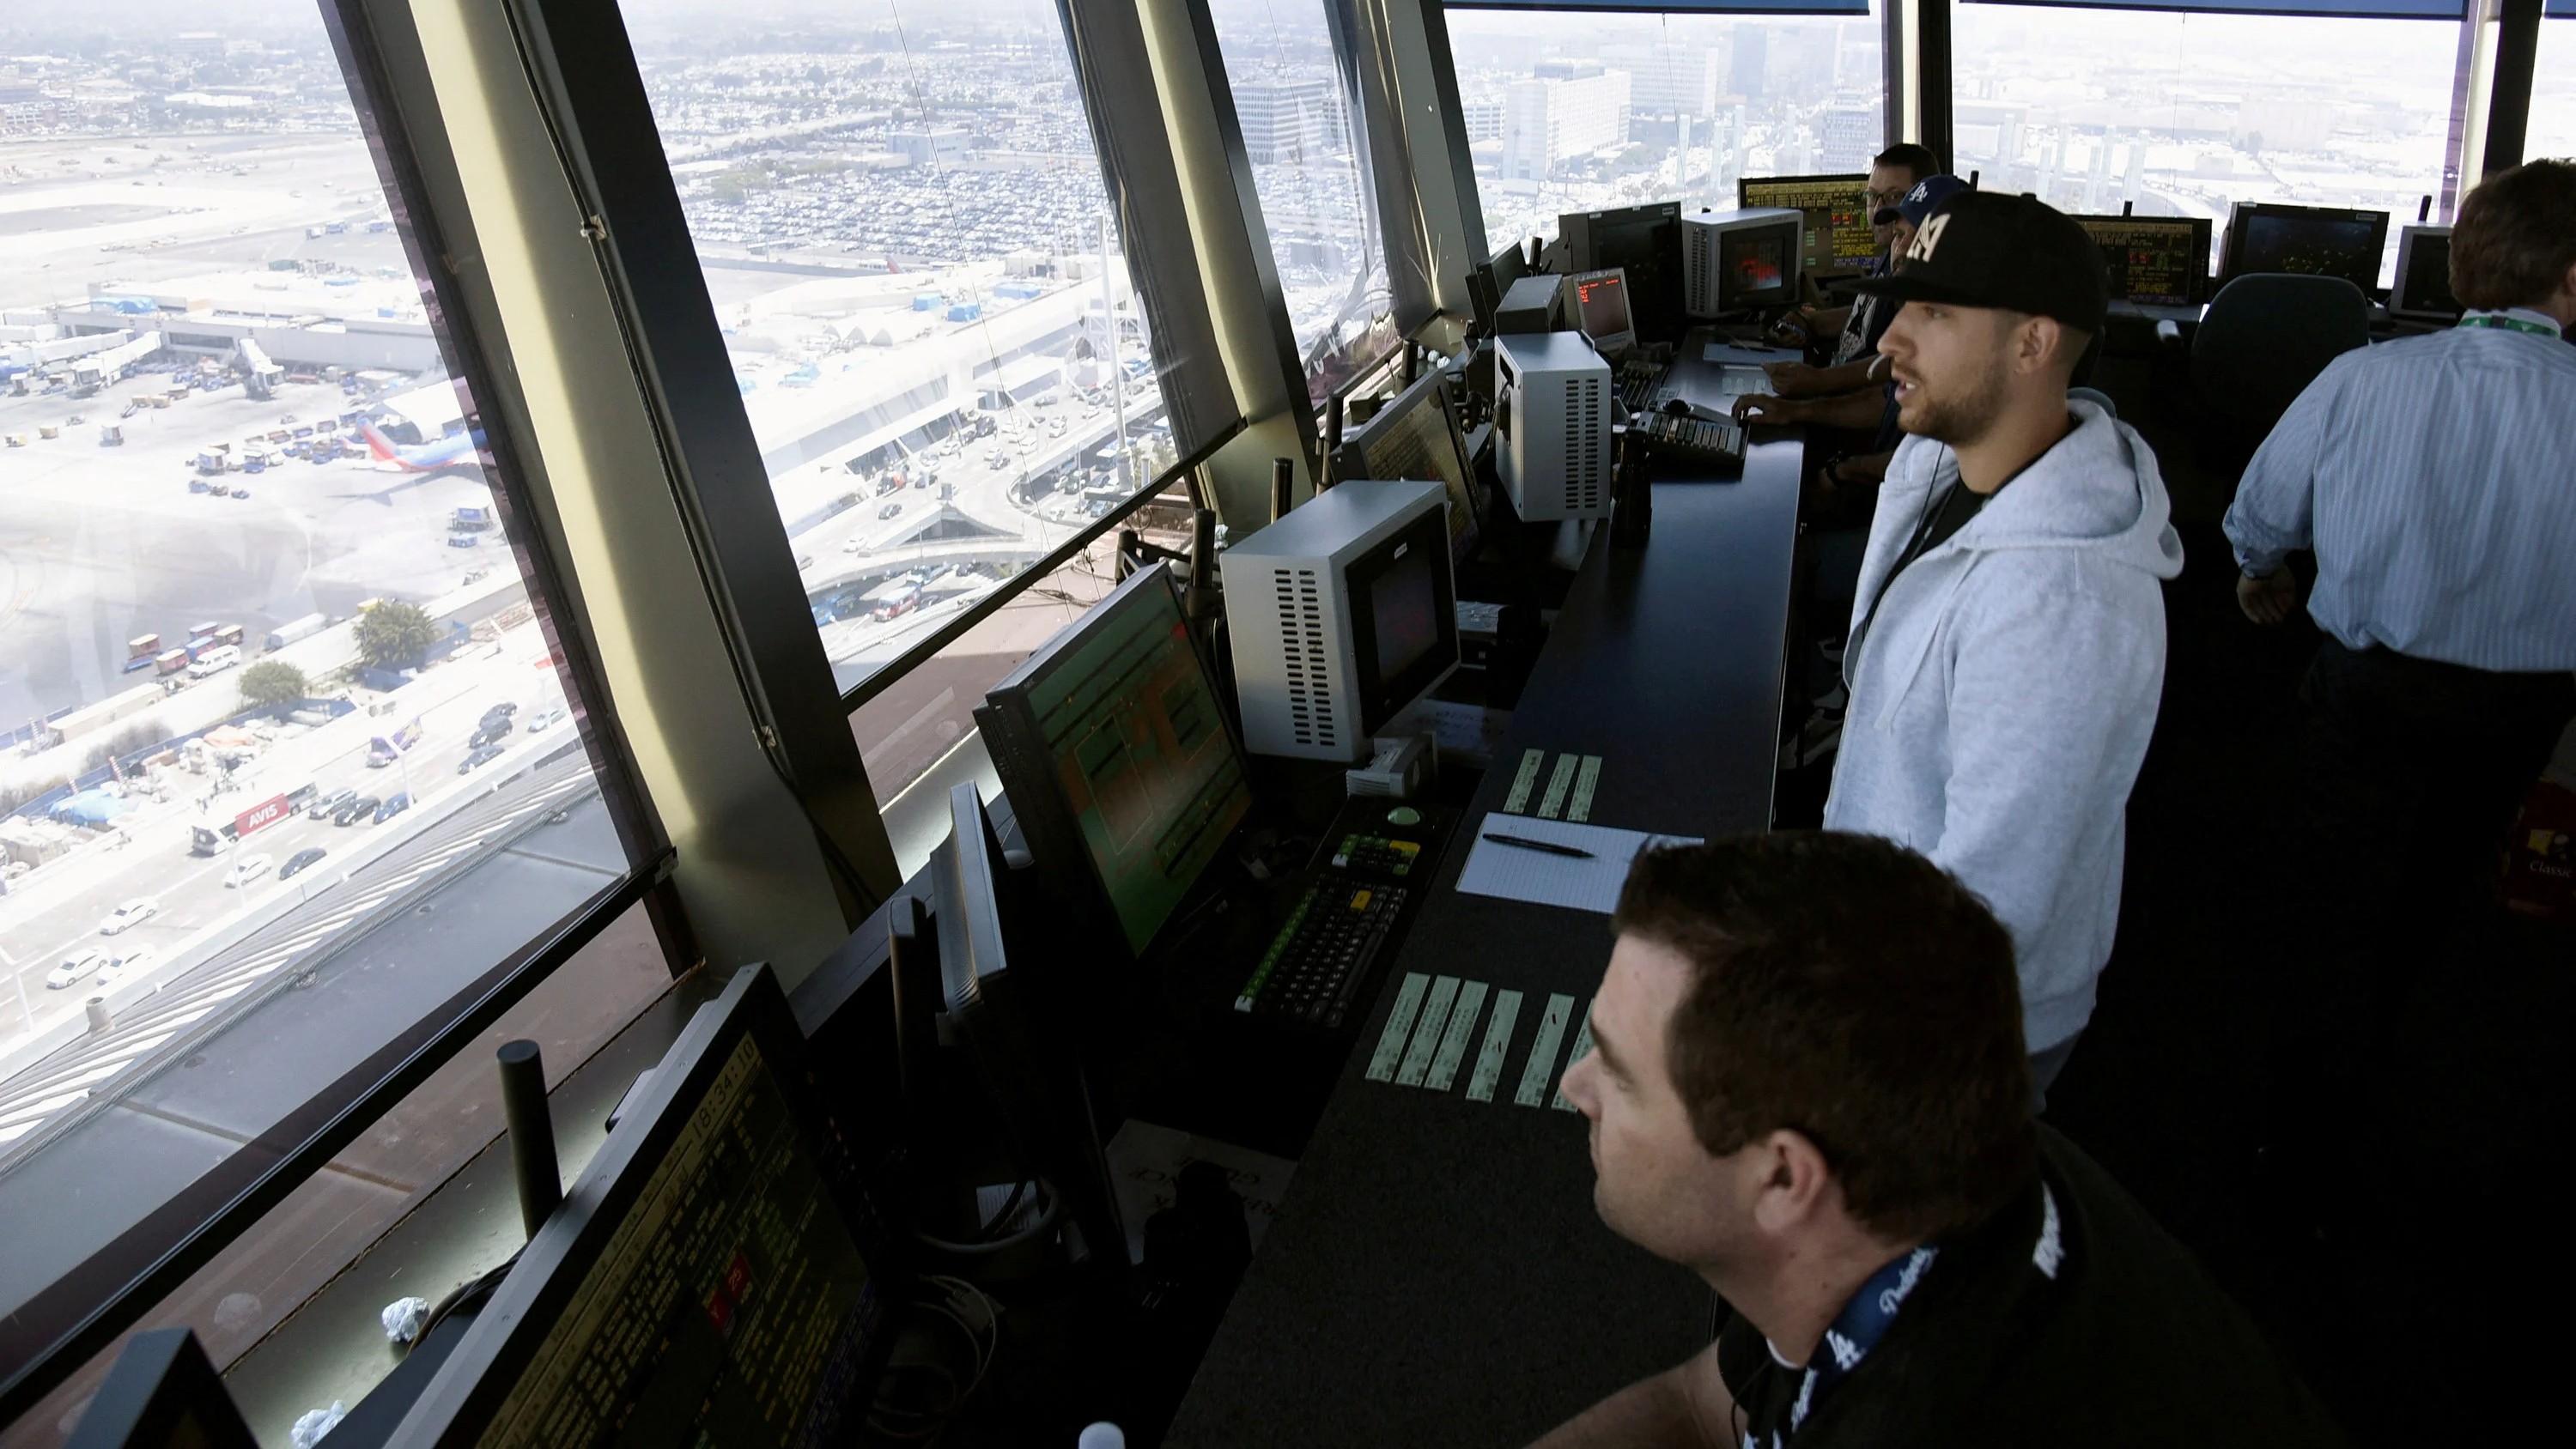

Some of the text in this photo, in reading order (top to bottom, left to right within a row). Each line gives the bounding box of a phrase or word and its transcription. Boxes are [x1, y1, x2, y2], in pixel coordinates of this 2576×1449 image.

[1908, 180, 1929, 203] LA
[248, 803, 278, 828] AVIS
[693, 1040, 756, 1139] 18:34:10
